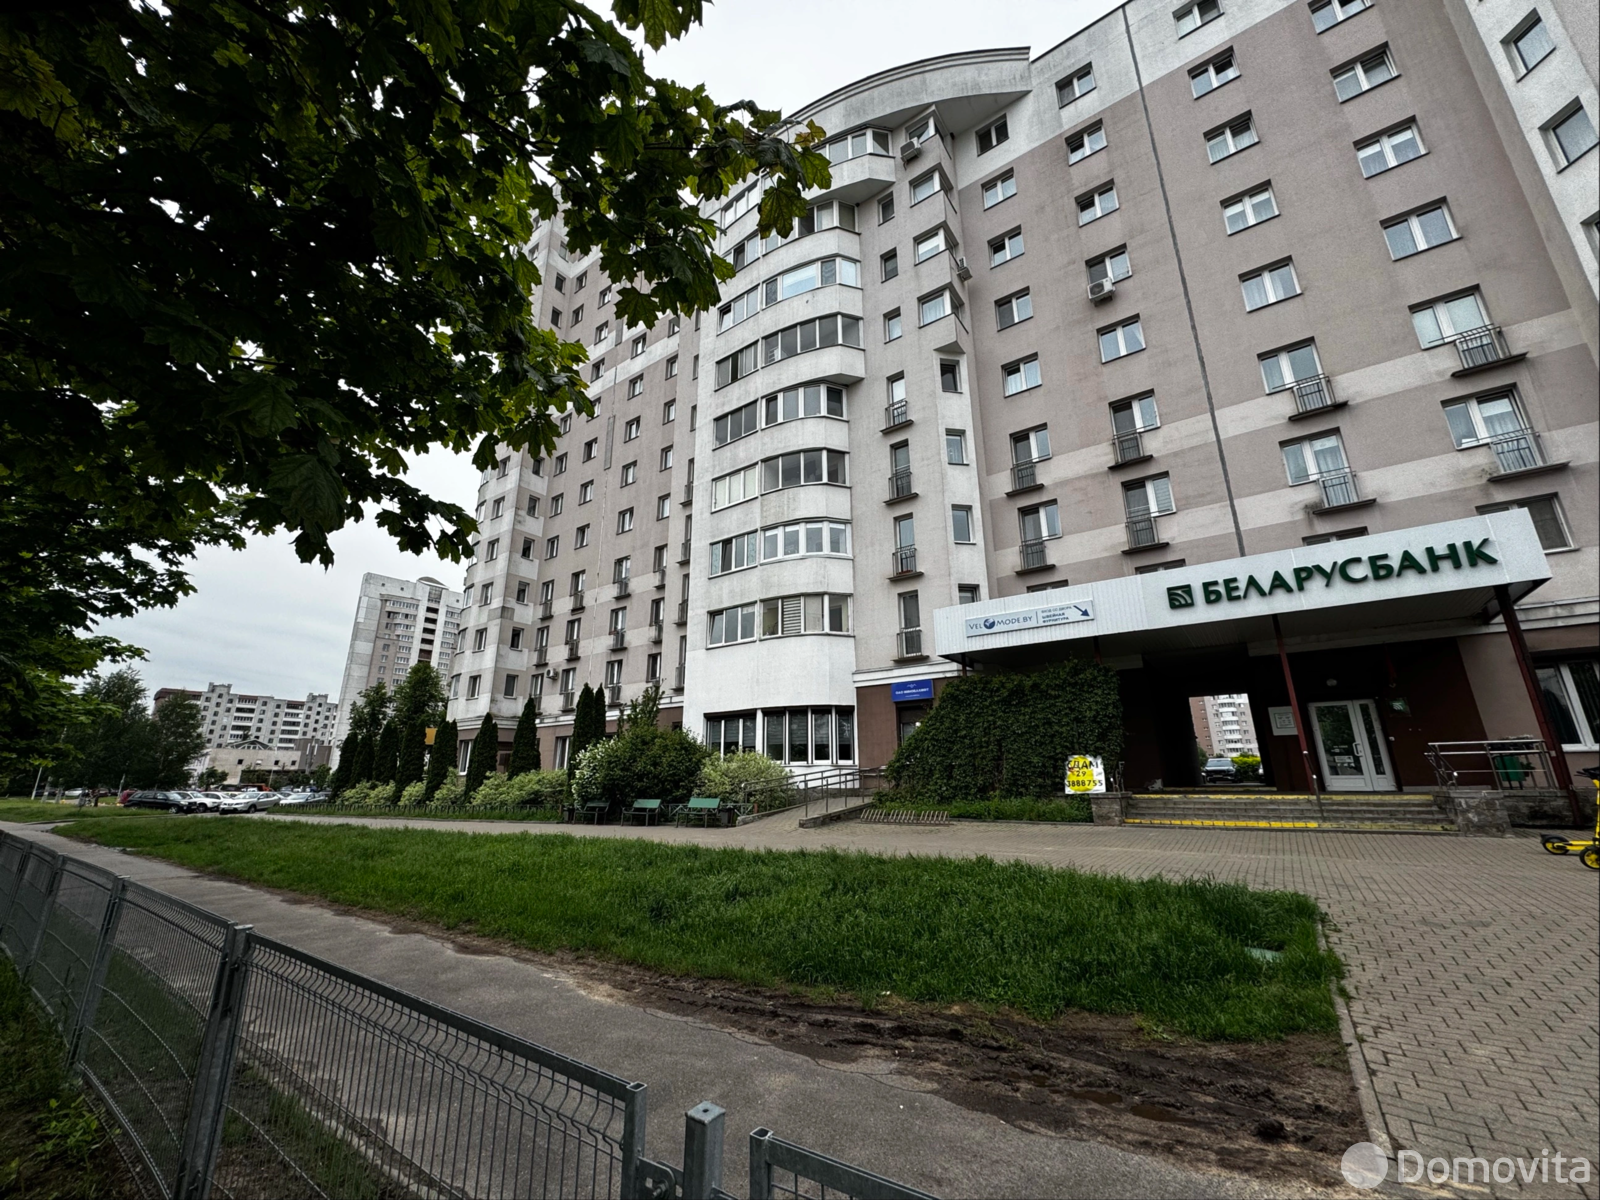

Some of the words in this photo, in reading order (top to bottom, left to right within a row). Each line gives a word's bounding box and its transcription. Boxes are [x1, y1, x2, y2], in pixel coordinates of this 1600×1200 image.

[1202, 537, 1499, 604] БЕЛАРУСБАНК
[1067, 760, 1099, 770] СДАМ
[1066, 779, 1104, 787] 3888755
